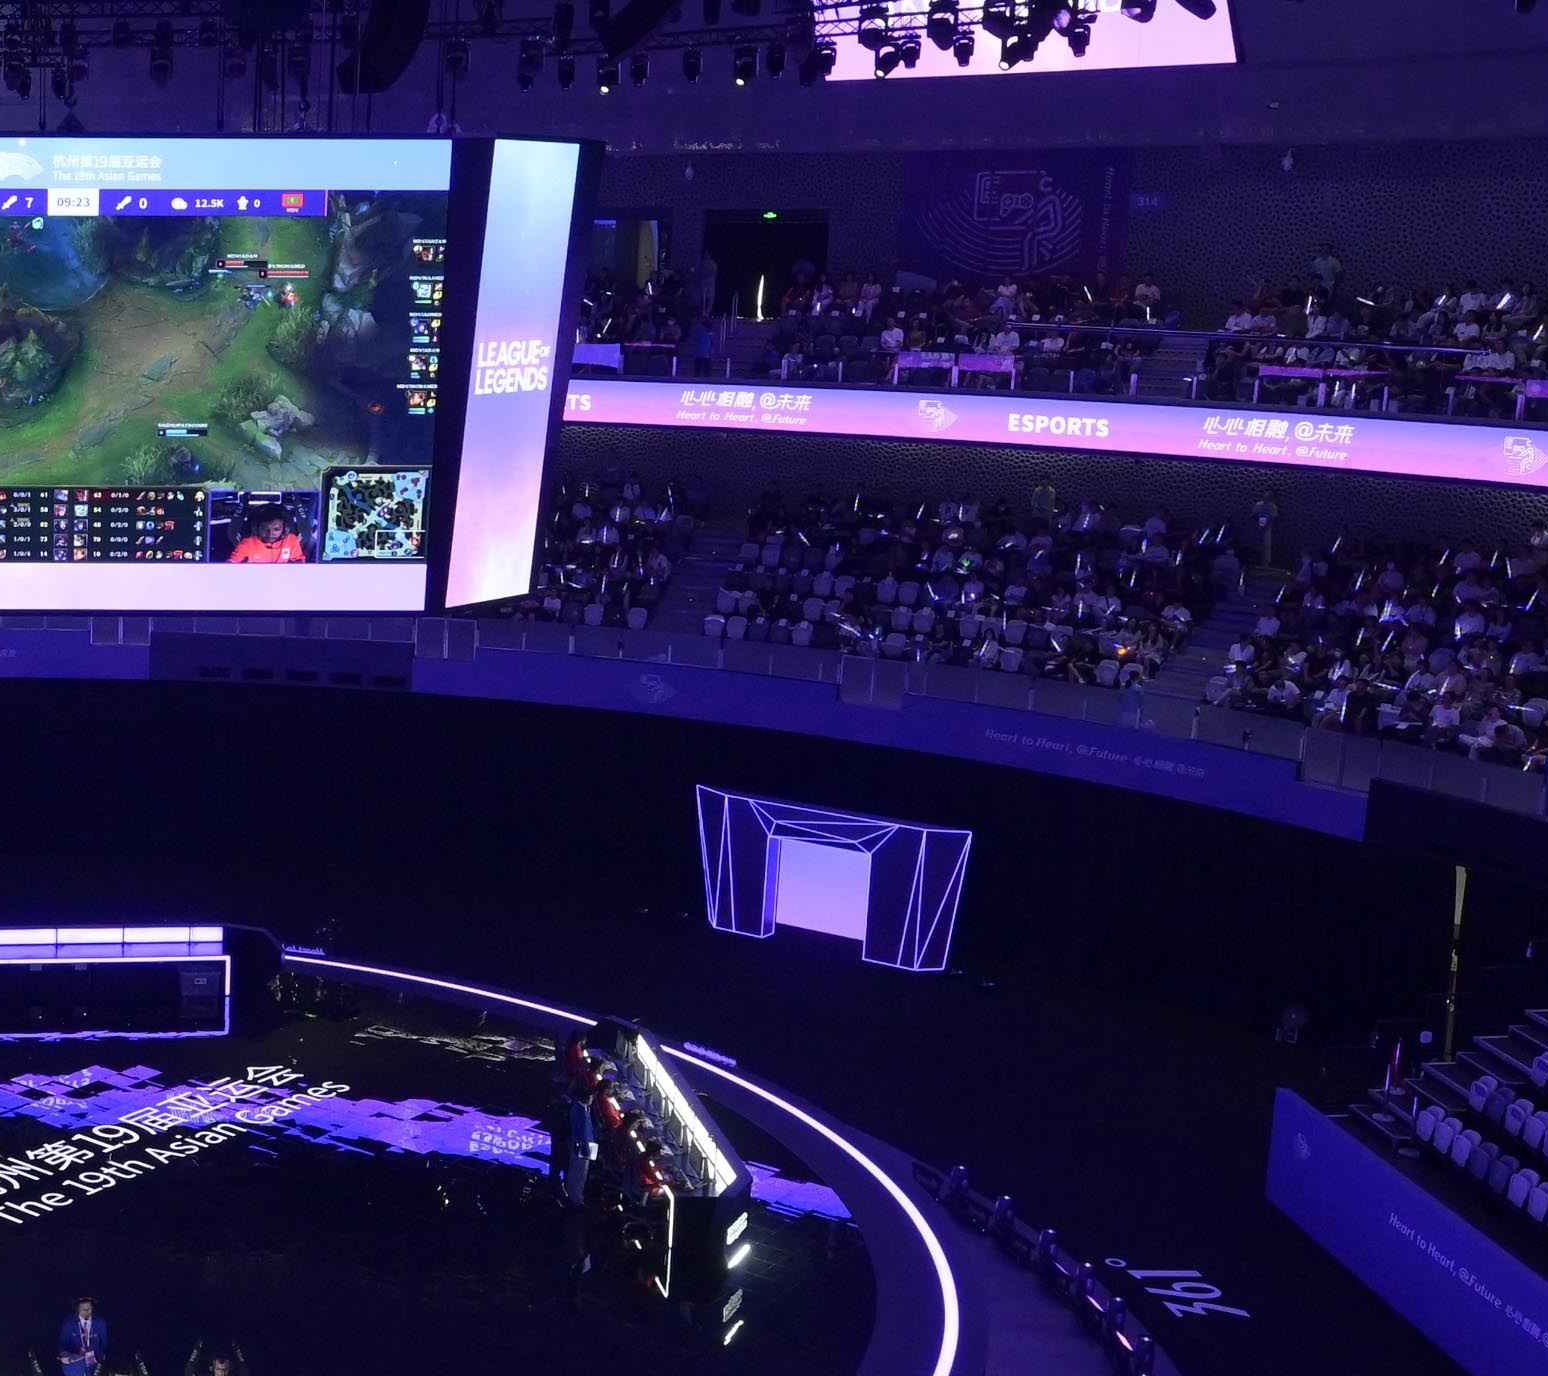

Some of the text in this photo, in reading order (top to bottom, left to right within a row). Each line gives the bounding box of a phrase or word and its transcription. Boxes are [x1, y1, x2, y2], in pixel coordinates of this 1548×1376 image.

[25, 197, 34, 208] 7
[57, 197, 91, 208] 09:23
[195, 199, 224, 208] 12.5K
[478, 339, 542, 368] LEAGUE
[474, 366, 548, 395] LEGENDS
[1007, 413, 1110, 438] ESPORTS
[1198, 439, 1232, 452] Heart
[1235, 441, 1248, 453] to
[1295, 446, 1348, 461] @Future
[64, 1154, 154, 1197] 19th
[158, 1120, 247, 1170] Asian
[234, 1077, 352, 1133] Games
[1388, 1211, 1416, 1241] Heart
[1416, 1233, 1427, 1250] to
[1458, 1266, 1503, 1310] @Future
